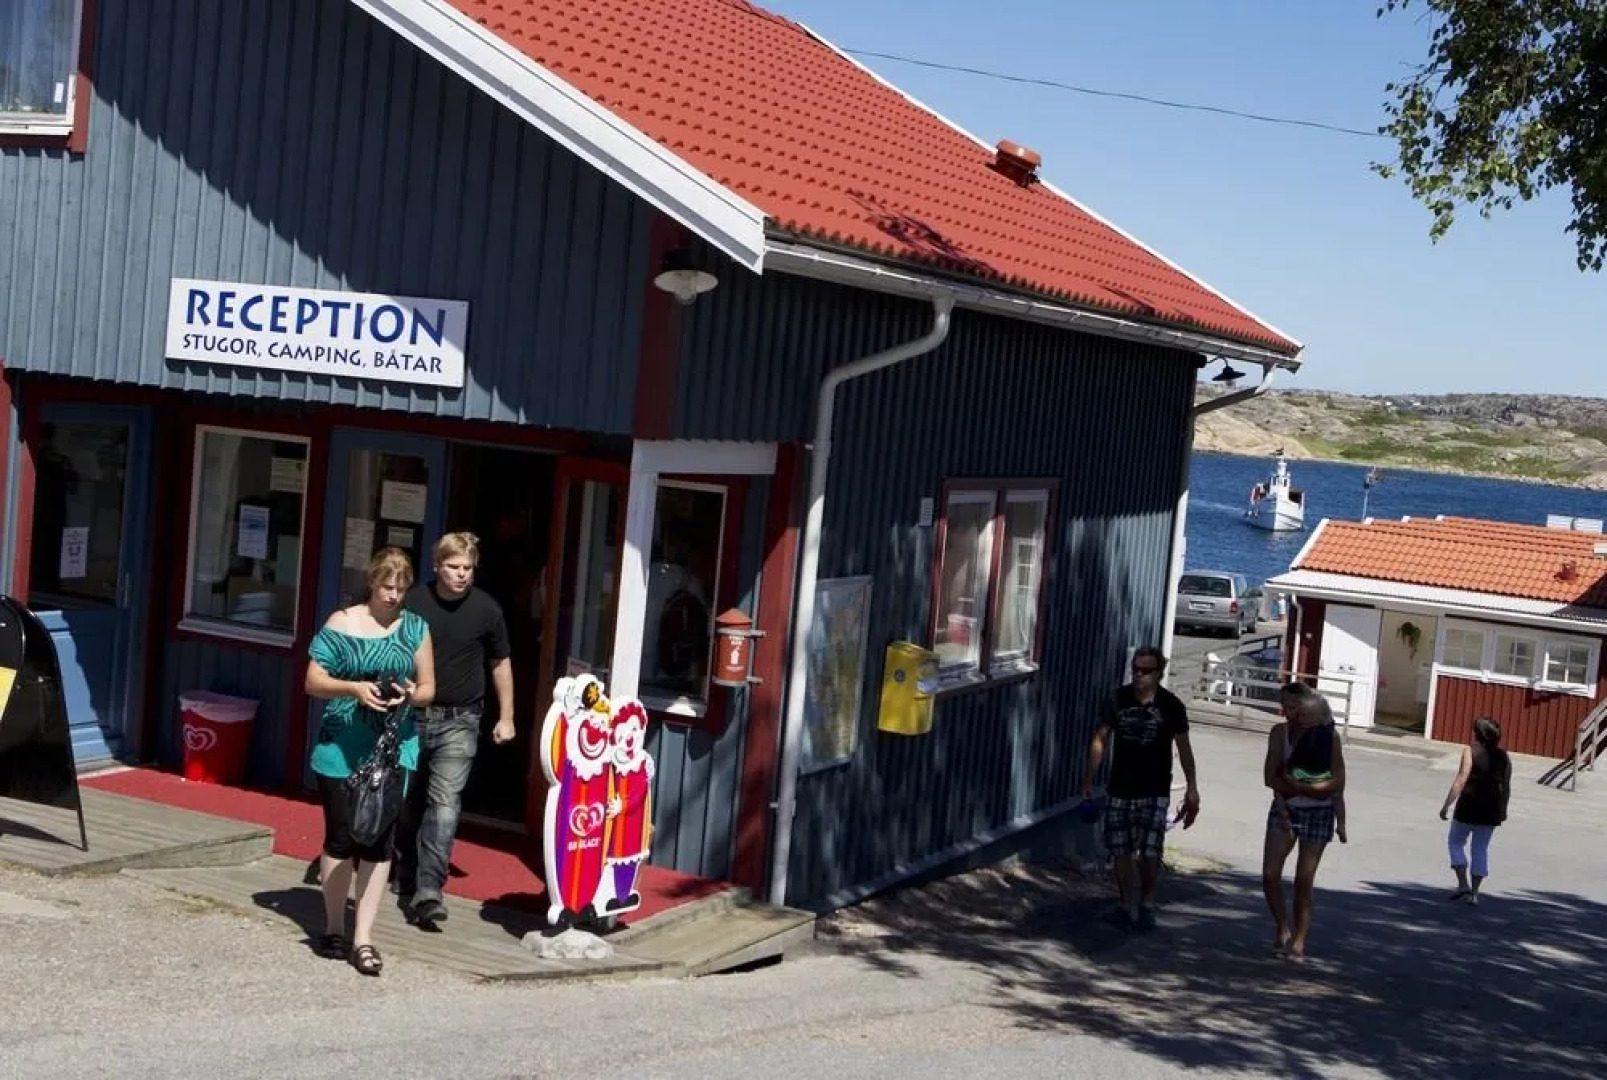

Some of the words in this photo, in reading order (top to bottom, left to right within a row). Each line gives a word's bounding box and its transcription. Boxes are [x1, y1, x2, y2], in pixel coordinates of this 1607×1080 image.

[185, 288, 446, 348] RECEPTION
[182, 333, 263, 358] STUGOR,
[267, 341, 367, 369] CAMPING,
[373, 349, 443, 374] BÅTAR
